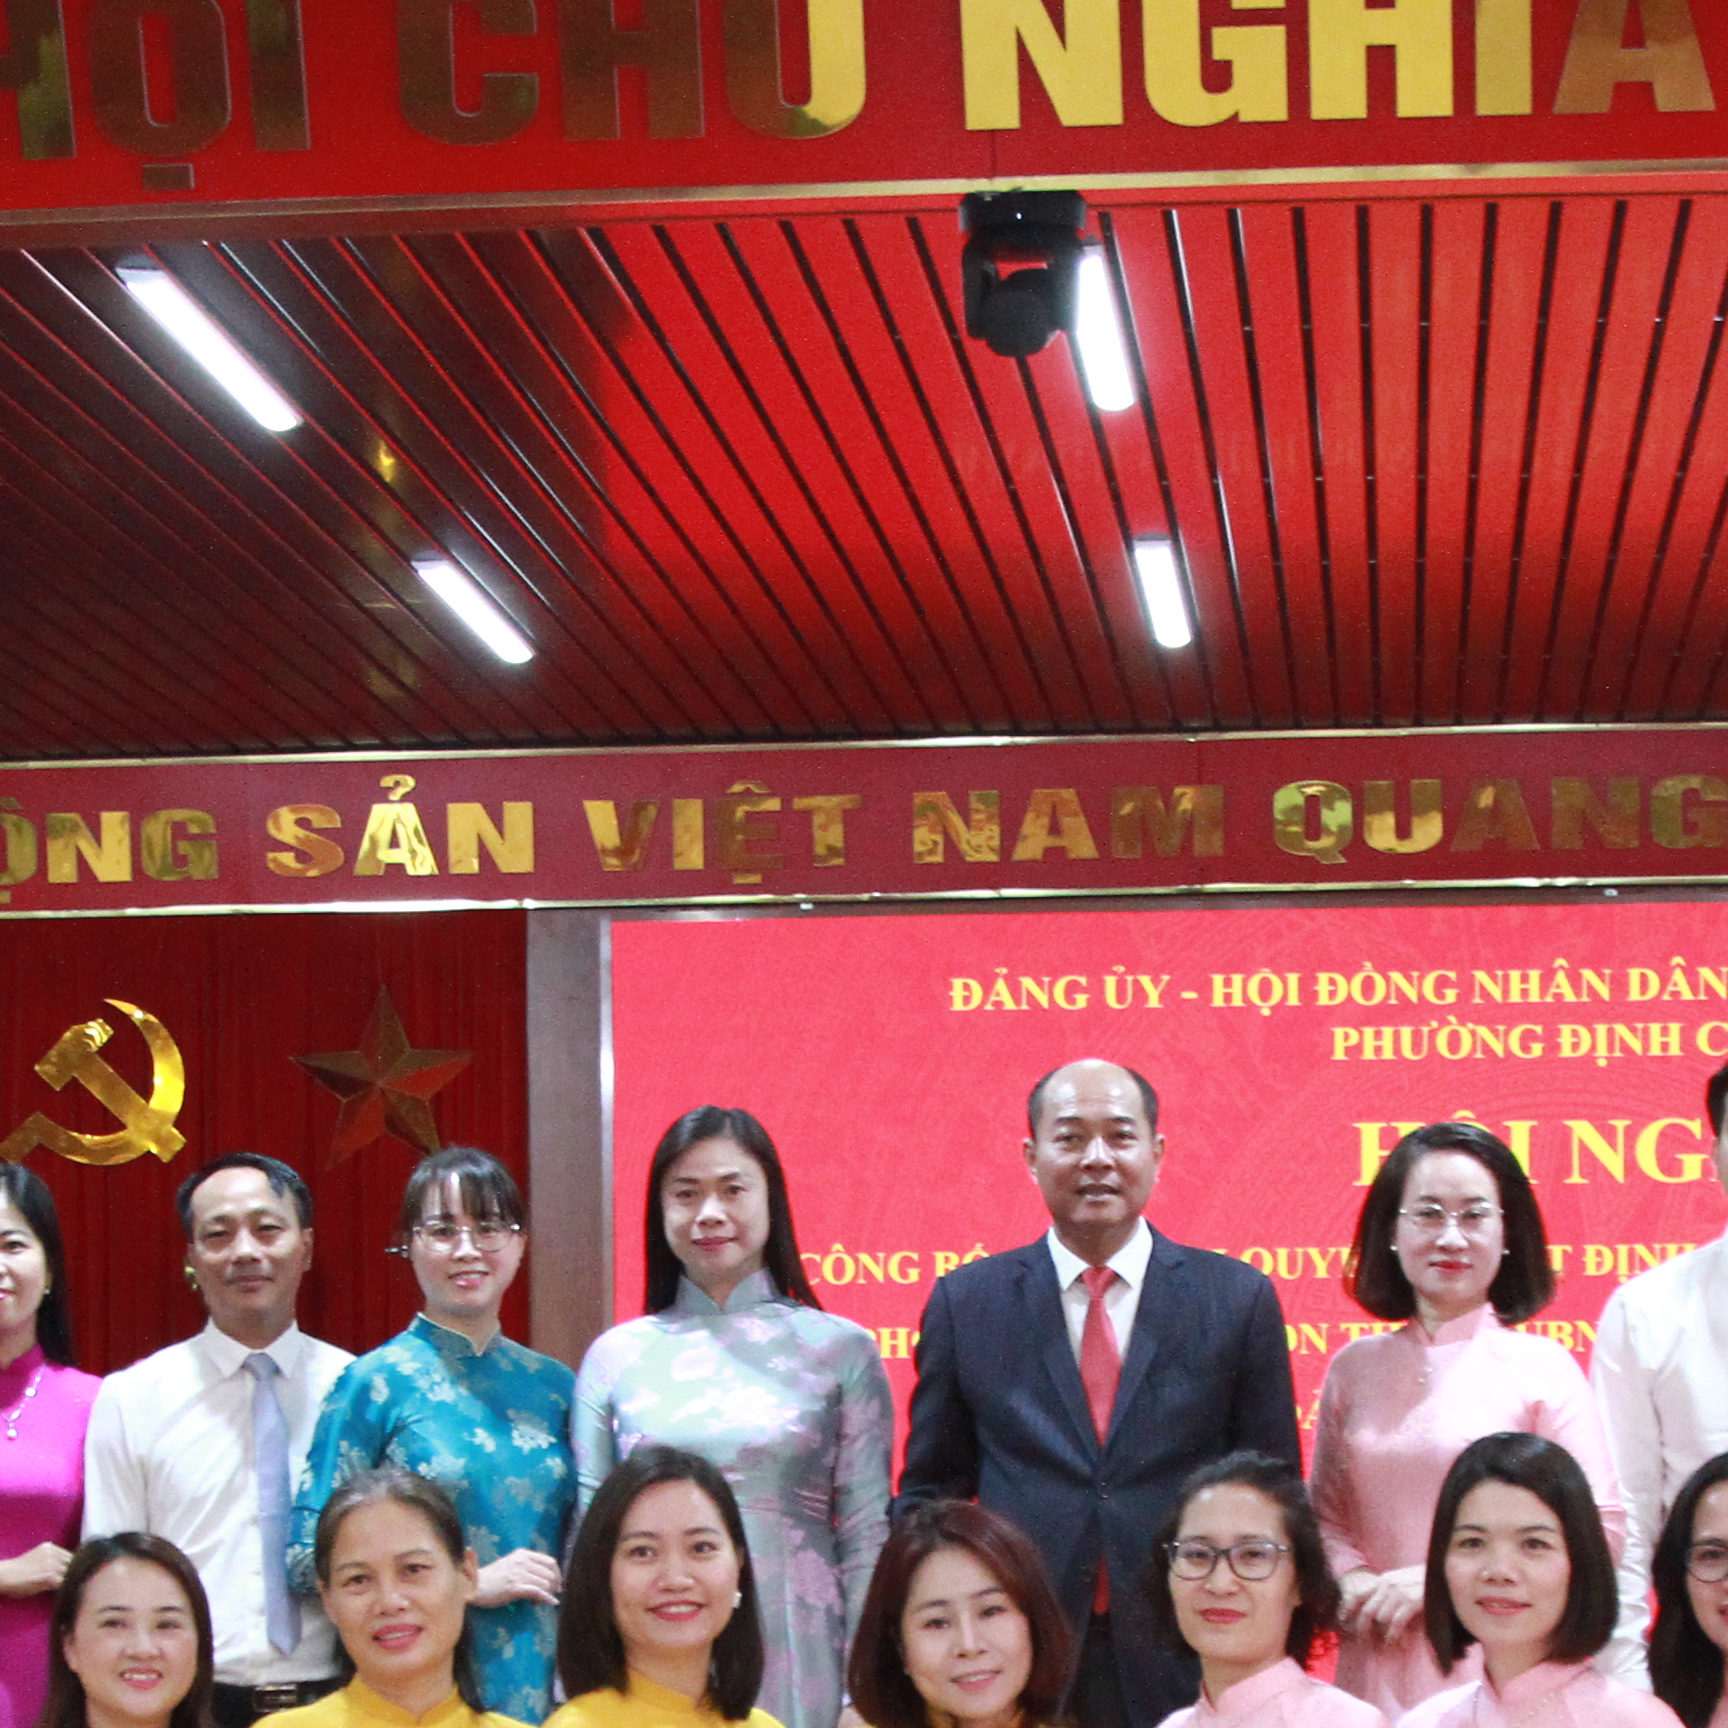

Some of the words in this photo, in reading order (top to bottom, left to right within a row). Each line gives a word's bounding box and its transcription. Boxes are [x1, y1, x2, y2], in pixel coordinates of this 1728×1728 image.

[266, 774, 536, 878] SẢN
[582, 779, 863, 885] VIỆT
[911, 784, 1227, 866] NAM
[948, 967, 1091, 1012] ĐẢNG
[1103, 964, 1171, 1009] ỦY
[1209, 968, 1302, 1017] HỘI
[1313, 962, 1460, 1006] ĐỒNG
[1471, 957, 1612, 1003] NHÂN
[1329, 1015, 1545, 1061] PHƯỜNG
[1557, 1022, 1684, 1067] ĐỊNH
[1563, 1118, 1719, 1184] NG
